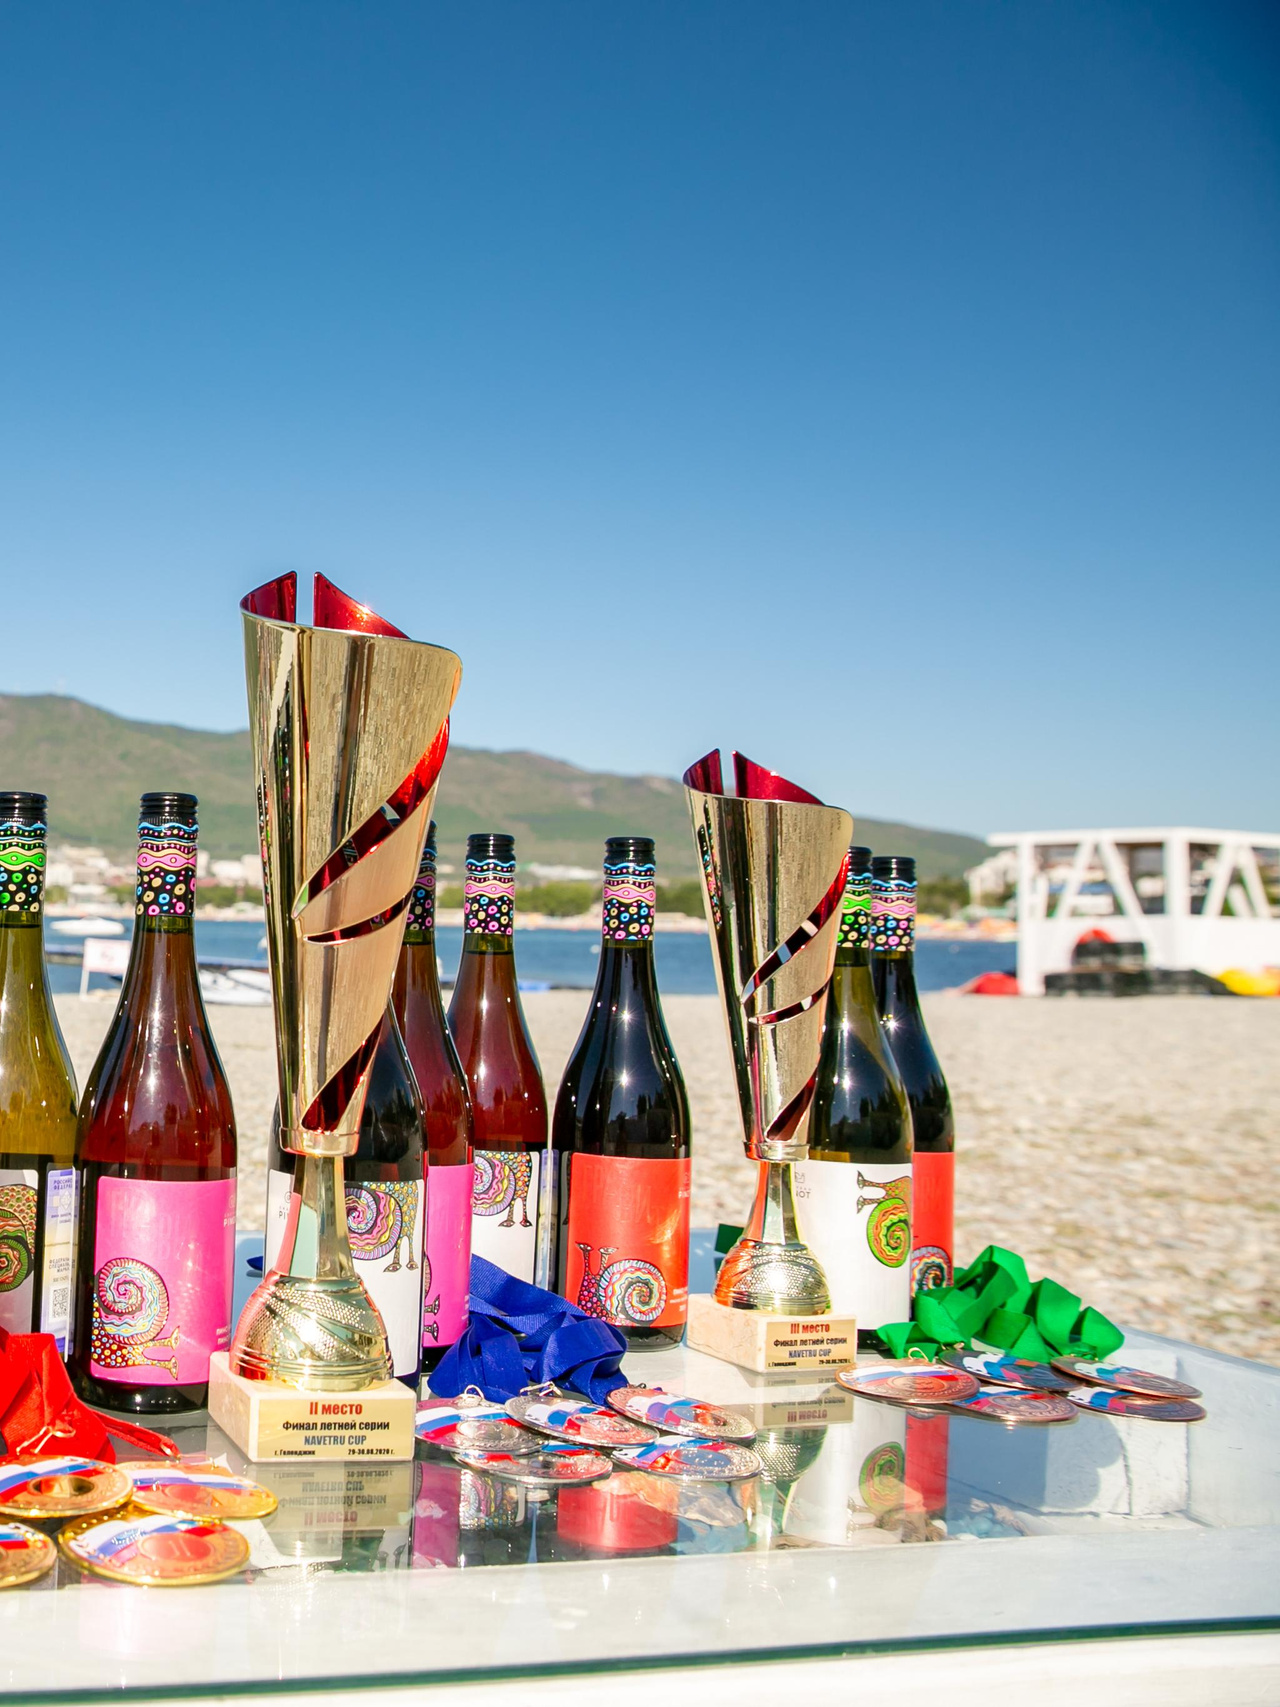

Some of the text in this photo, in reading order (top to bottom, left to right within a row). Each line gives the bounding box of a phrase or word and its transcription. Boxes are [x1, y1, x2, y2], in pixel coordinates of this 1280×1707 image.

[802, 1323, 831, 1334] место
[818, 1348, 832, 1357] CUP
[309, 1401, 363, 1415] II место
[282, 1420, 390, 1432] Финал летней серии
[304, 1435, 367, 1446] NAVETRU CUP
